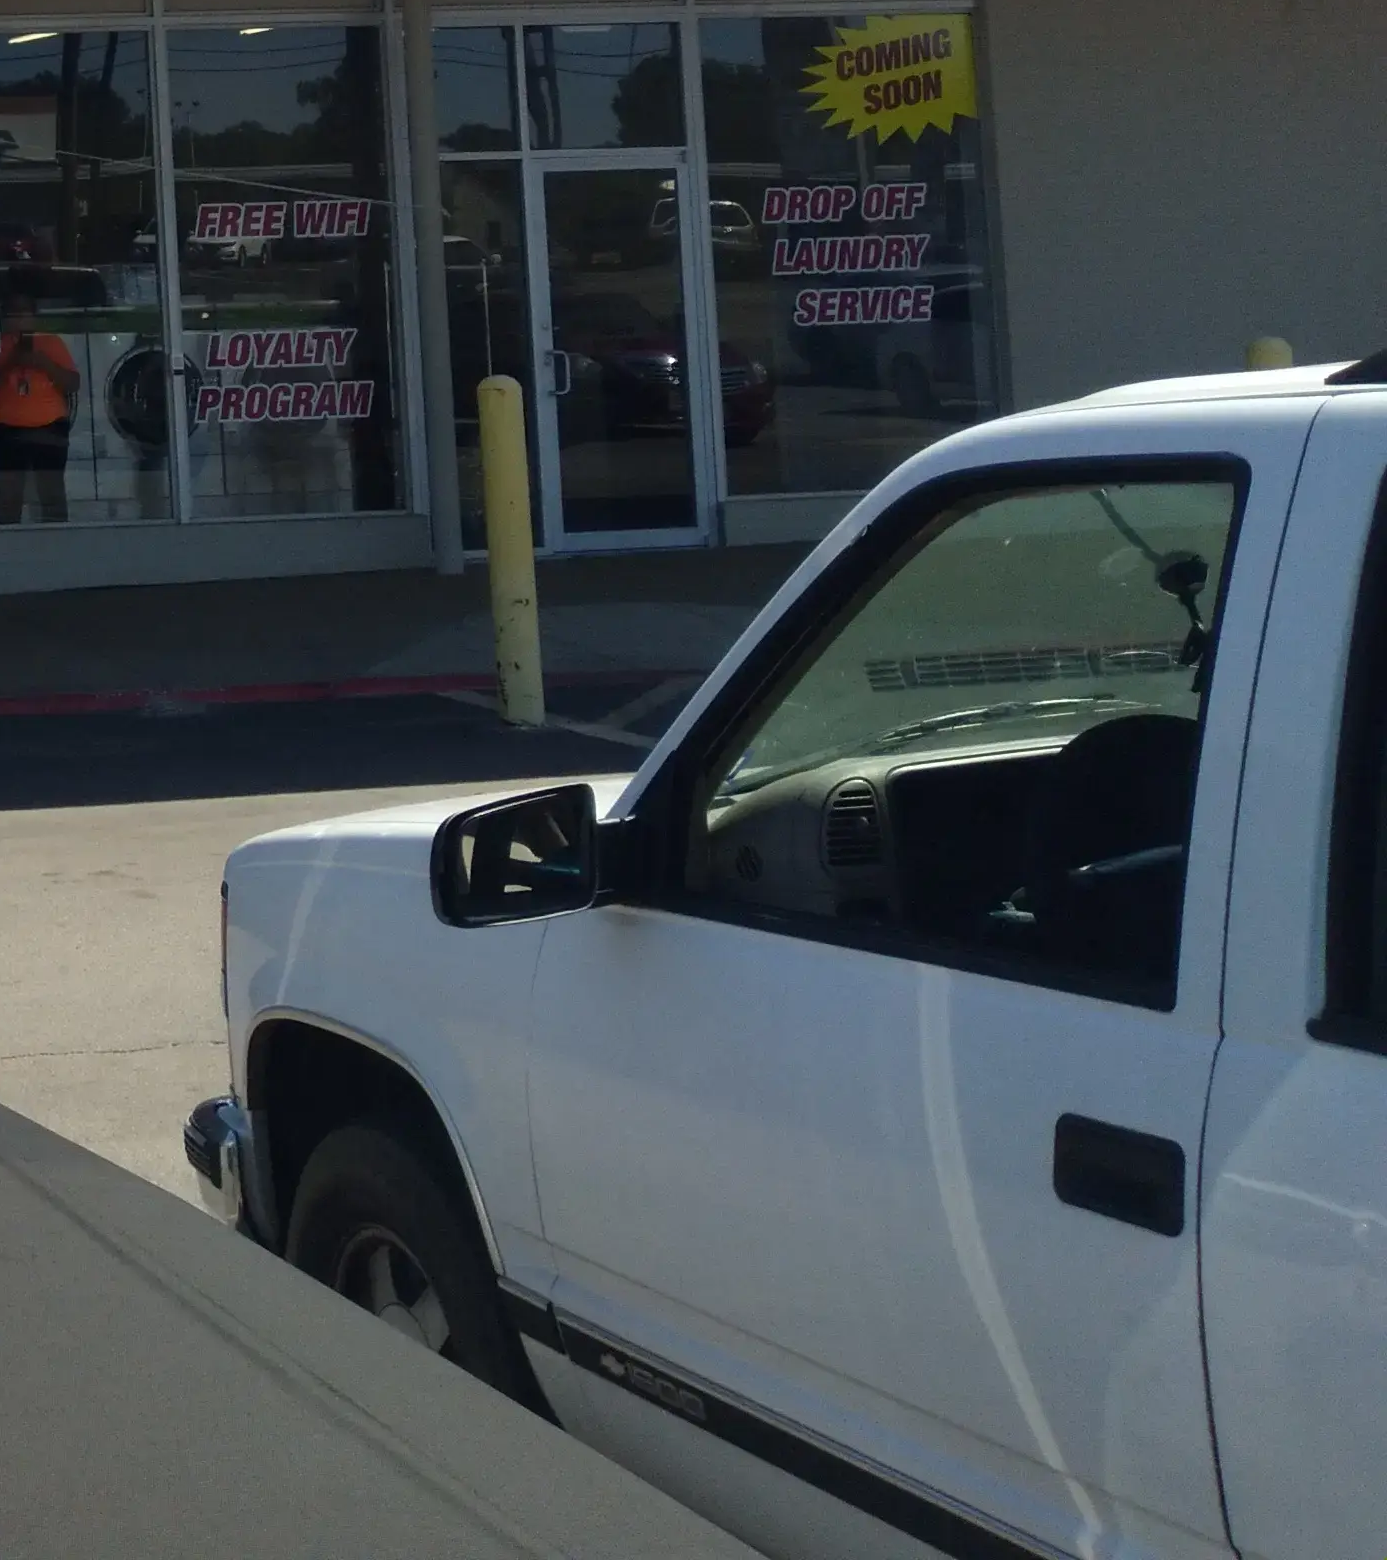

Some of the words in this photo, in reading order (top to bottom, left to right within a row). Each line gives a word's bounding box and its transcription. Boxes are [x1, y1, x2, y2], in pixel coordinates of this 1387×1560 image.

[835, 28, 952, 81] COMING
[864, 70, 943, 115] SOON
[194, 202, 287, 239] FREE
[293, 200, 371, 238] WIFI
[762, 186, 856, 224] DROP
[861, 183, 927, 221] OFF
[772, 234, 930, 275] LAUNDRY
[793, 286, 935, 327] SERVICE
[205, 328, 358, 370] LOYALTY
[194, 381, 375, 423] PROGRAM
